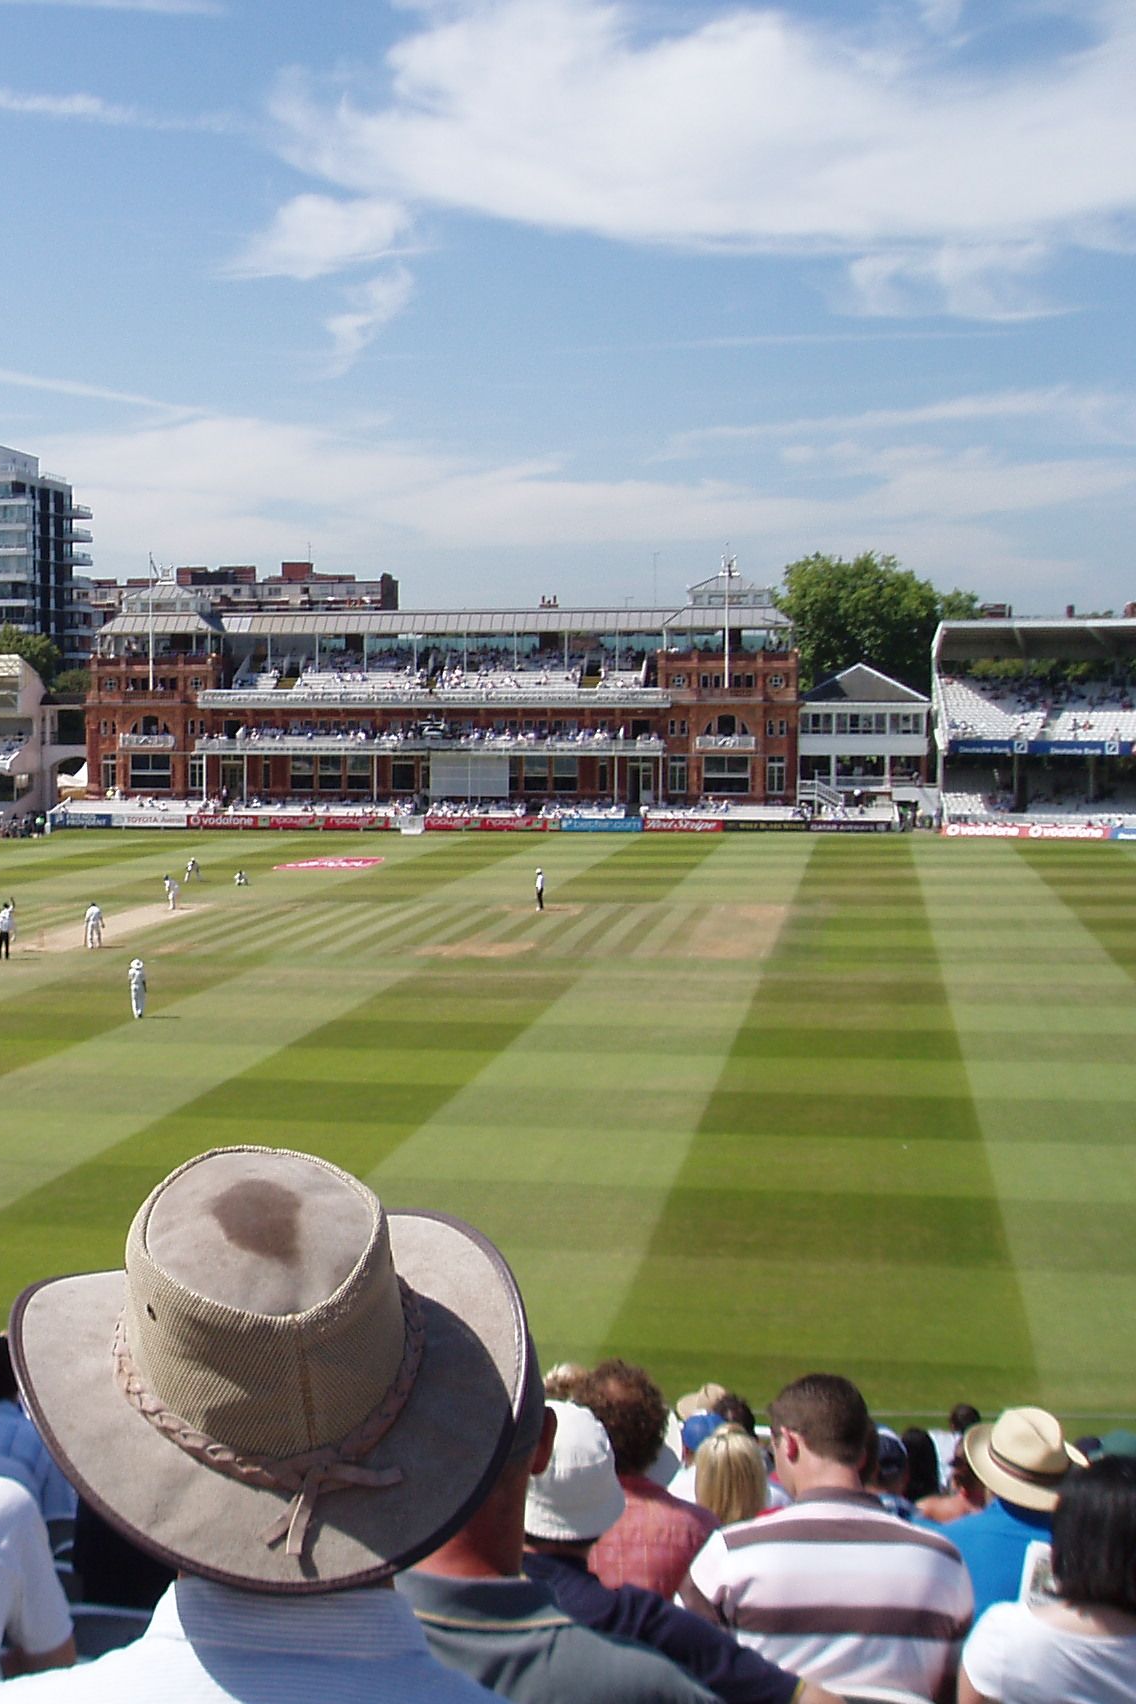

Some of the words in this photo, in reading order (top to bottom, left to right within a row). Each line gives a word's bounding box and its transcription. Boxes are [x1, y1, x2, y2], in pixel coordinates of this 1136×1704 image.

[127, 816, 158, 824] TOYOTA
[201, 815, 253, 825] vodafone
[330, 816, 371, 826] npower
[486, 818, 530, 827] npower
[645, 819, 673, 831] Red
[676, 819, 717, 832] Stripe
[961, 825, 1020, 836] vodafone
[1043, 826, 1104, 837] vodafone
